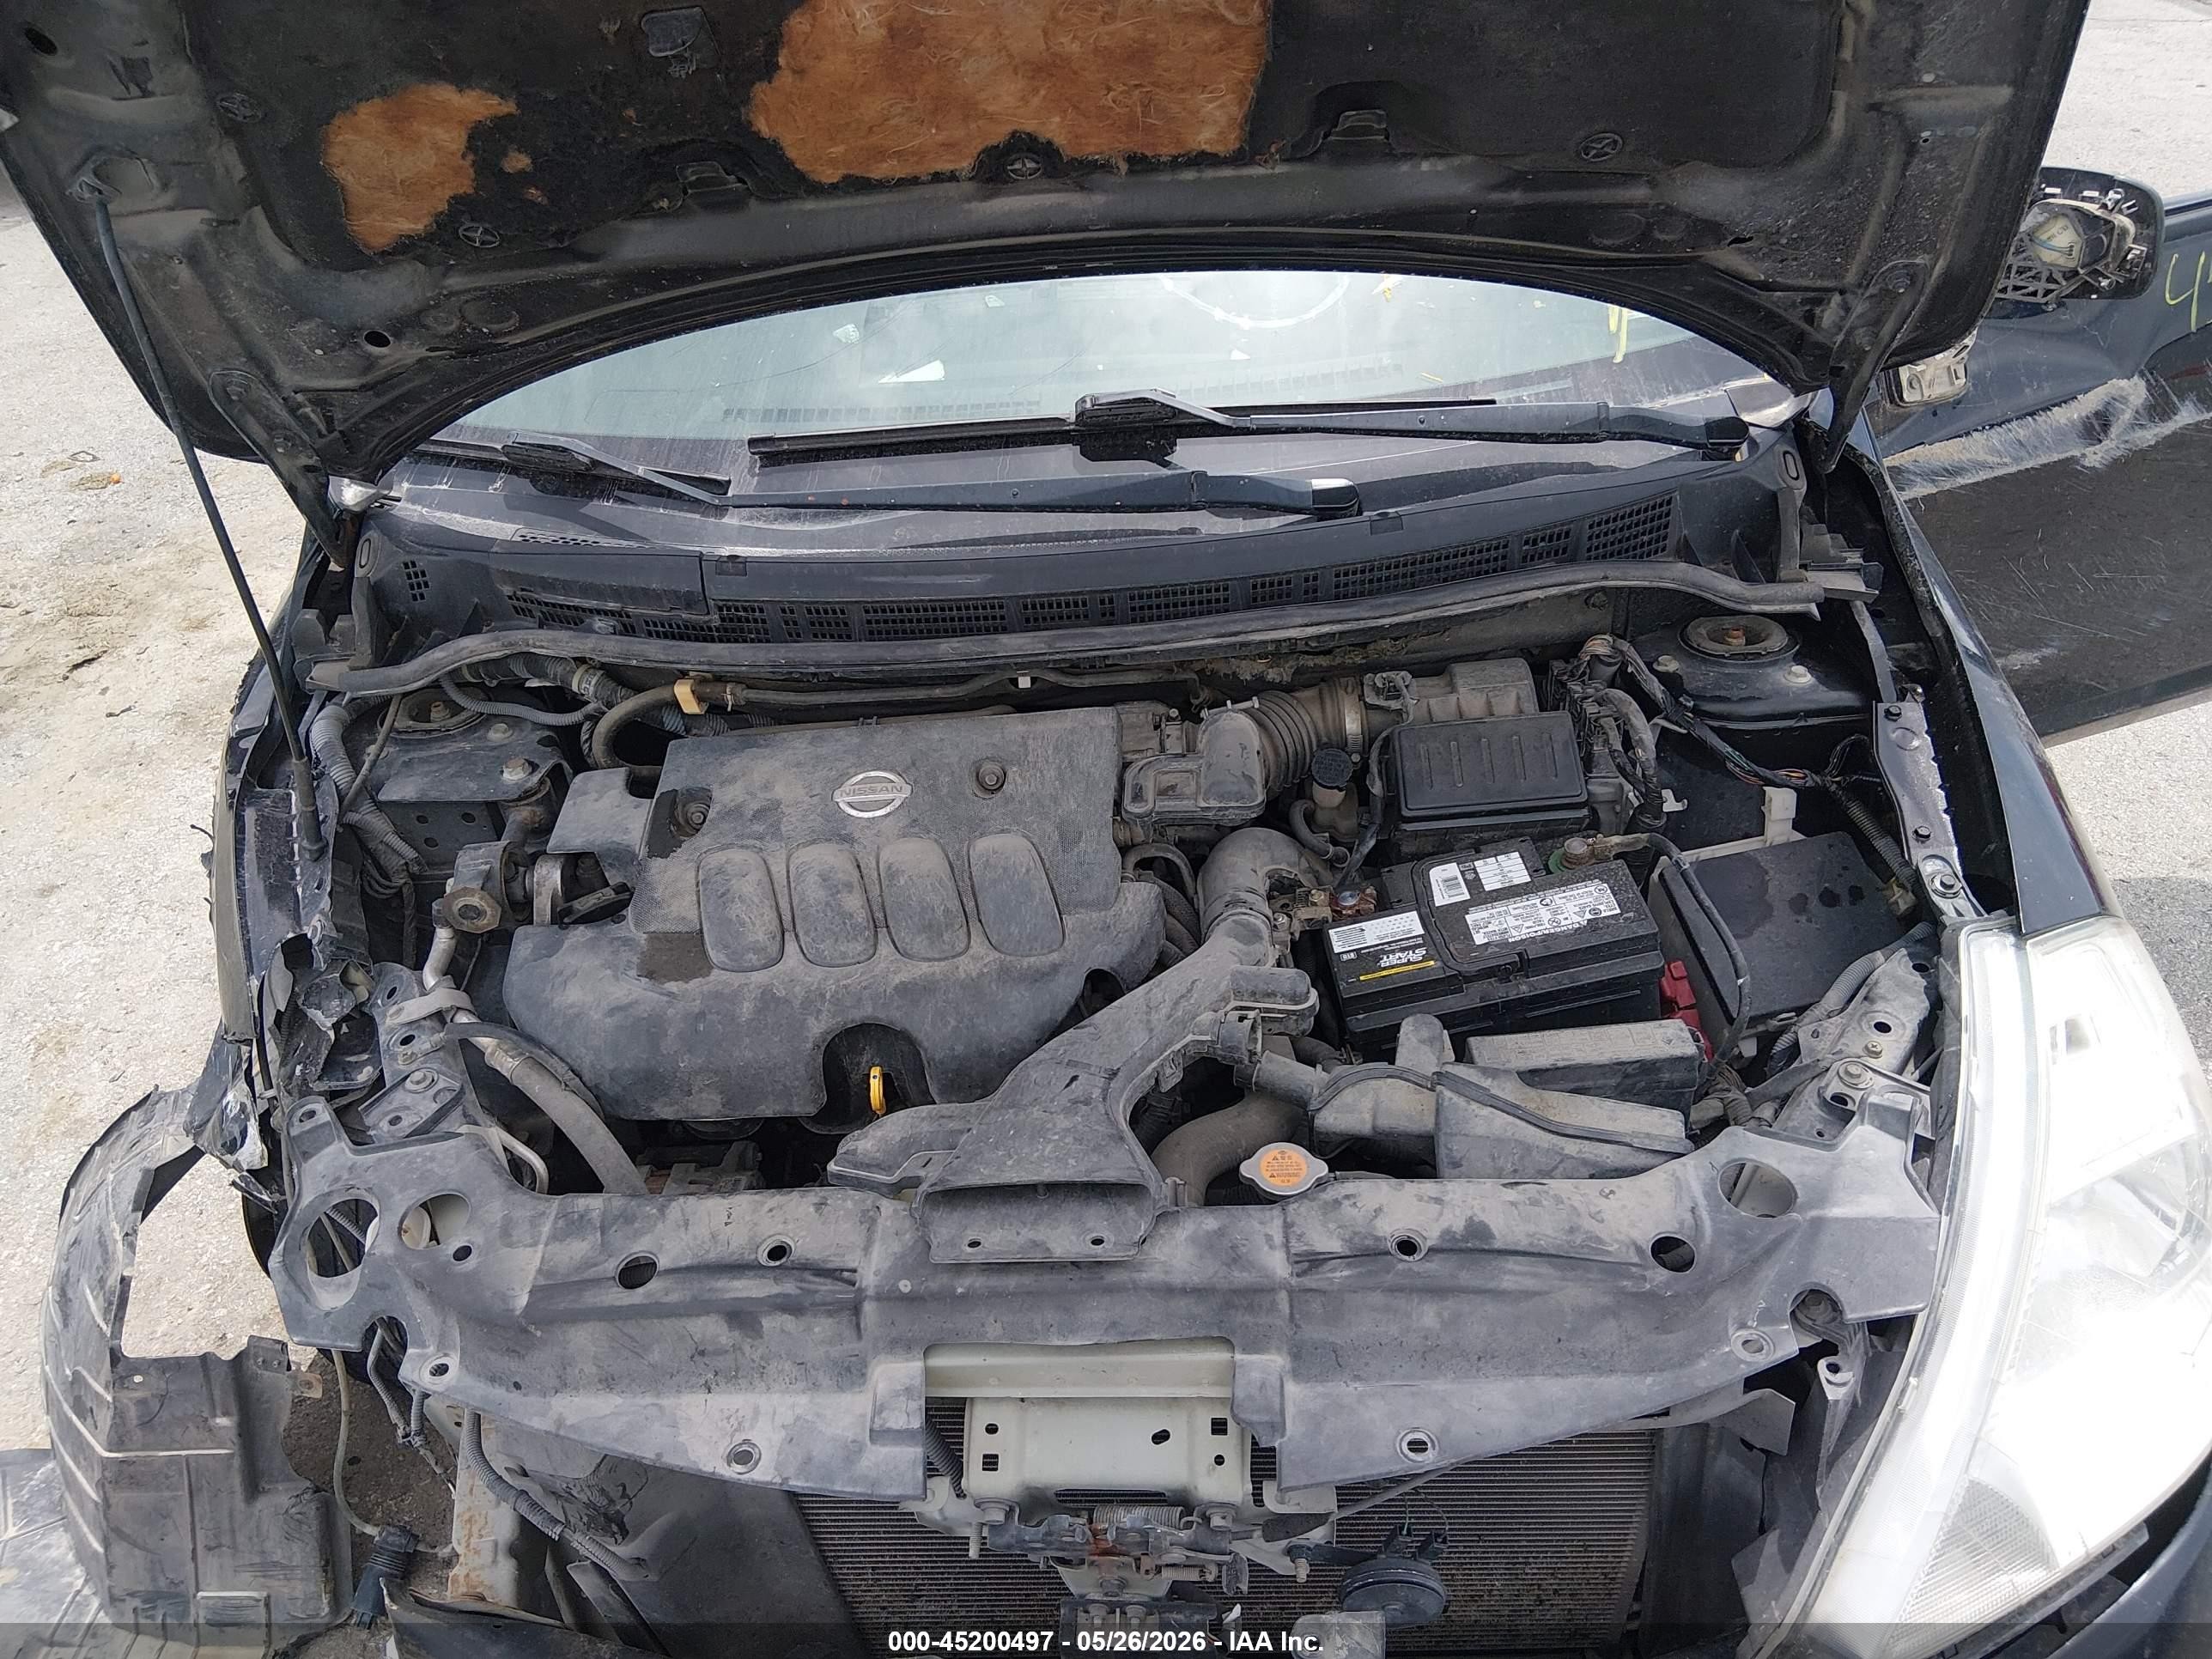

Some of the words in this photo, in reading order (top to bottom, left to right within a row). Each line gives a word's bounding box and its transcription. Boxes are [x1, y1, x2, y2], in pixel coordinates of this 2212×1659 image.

[839, 784, 903, 798] NISSAN
[1508, 921, 1581, 943] DANGER/POISON
[1379, 947, 1427, 963] START
[1380, 957, 1423, 968] SUPER
